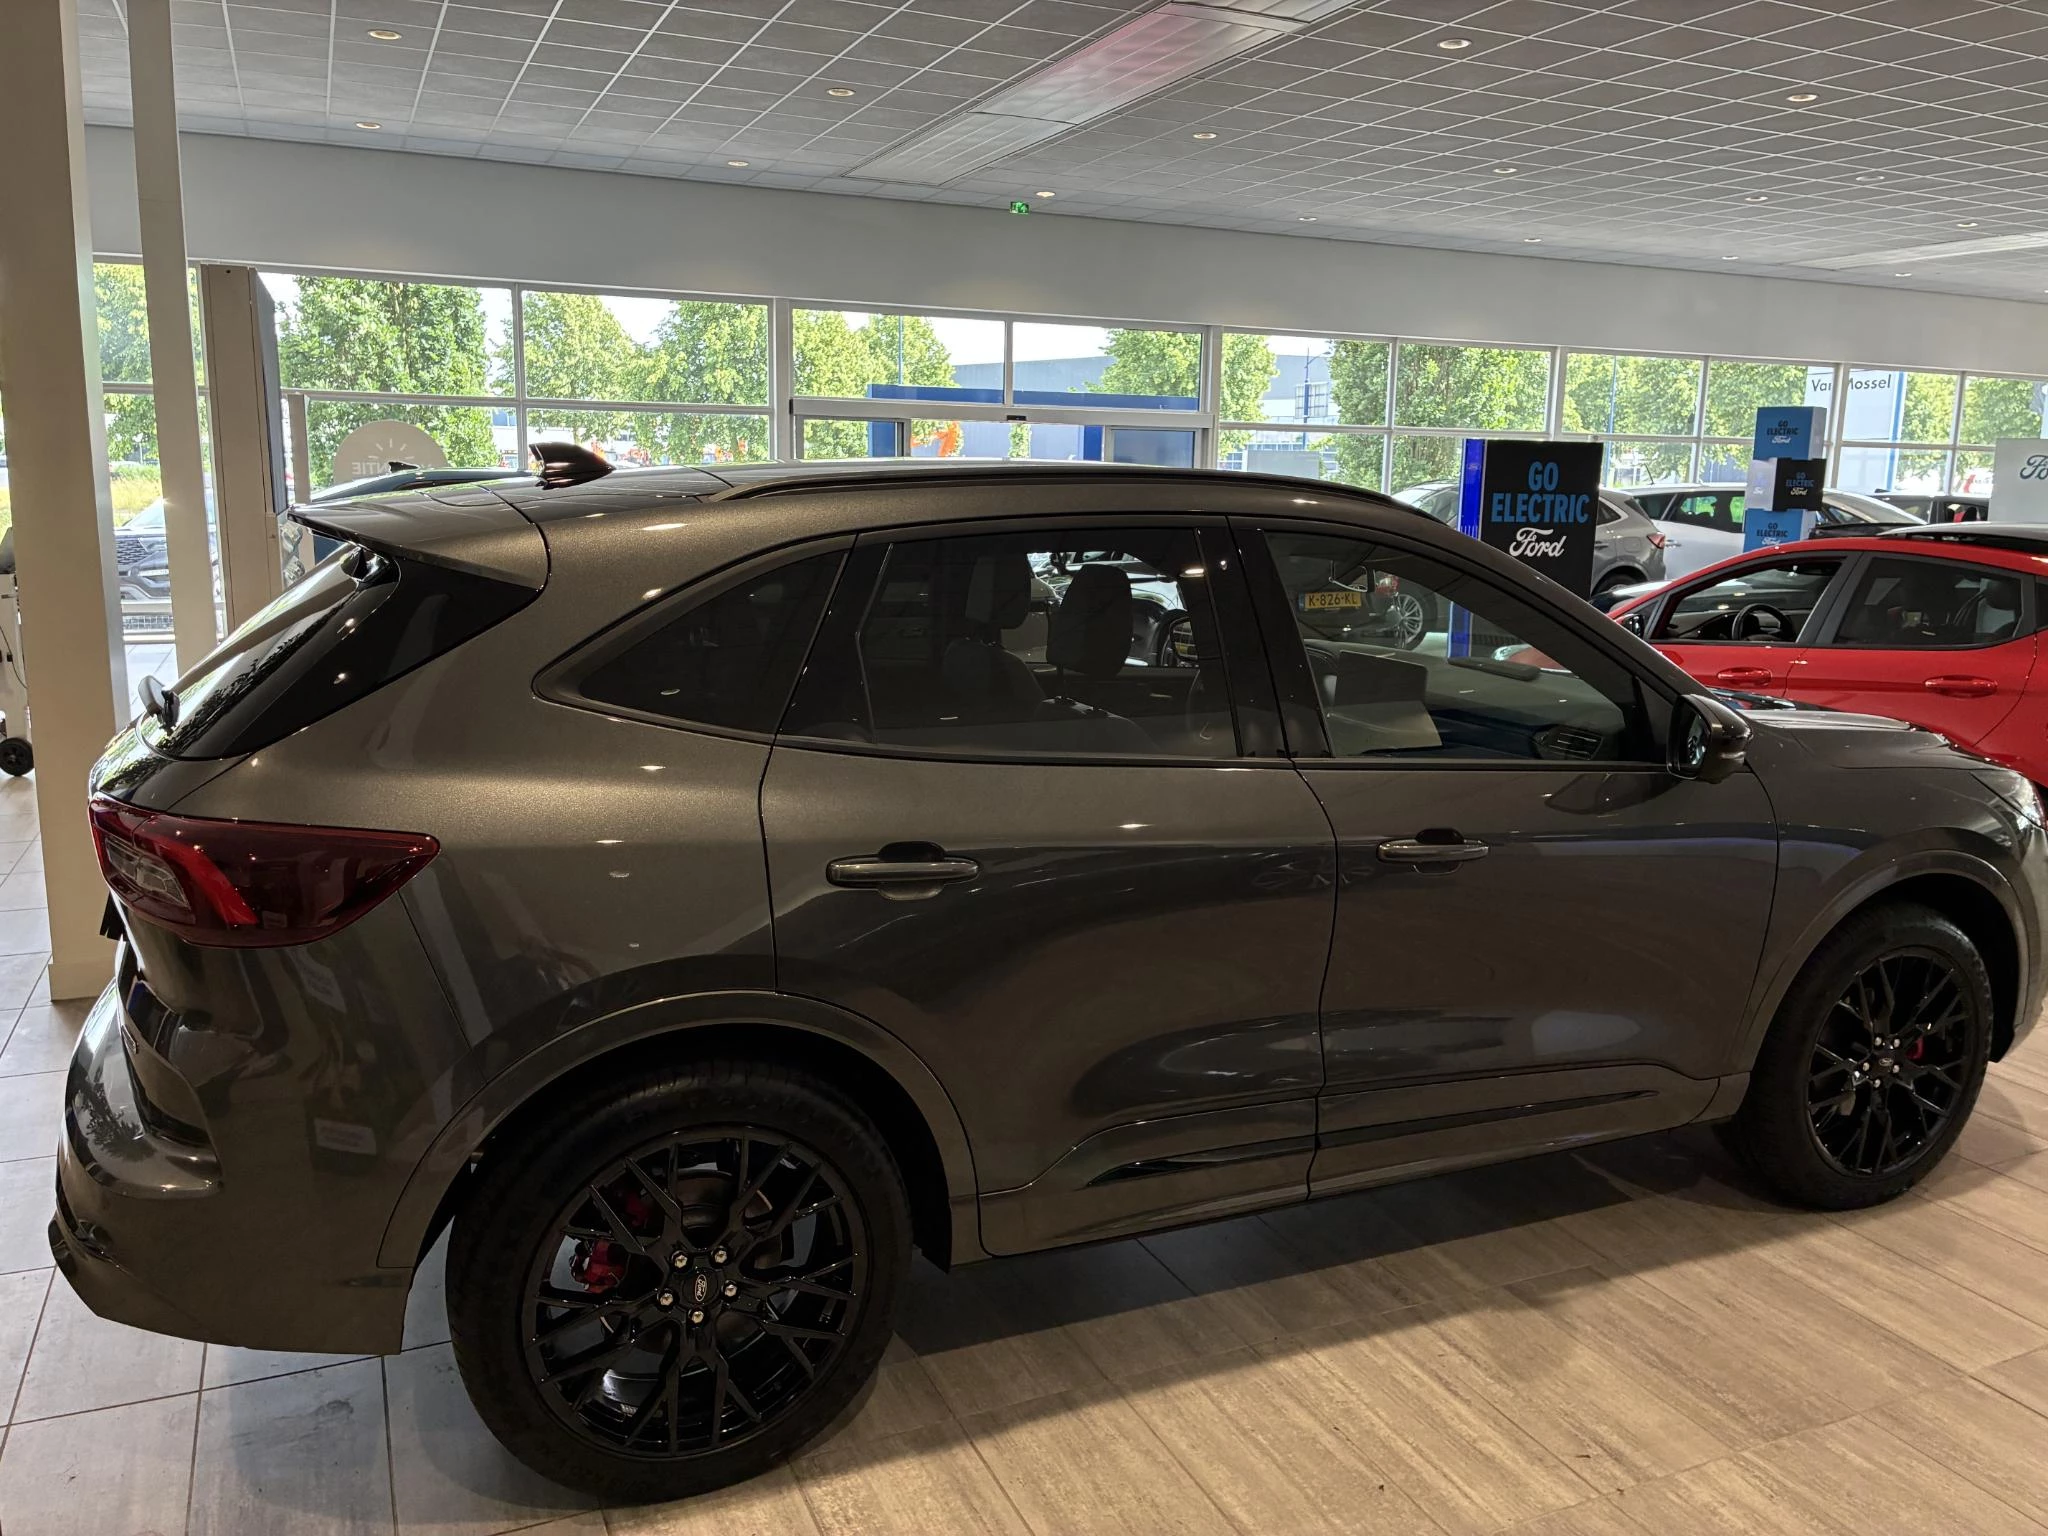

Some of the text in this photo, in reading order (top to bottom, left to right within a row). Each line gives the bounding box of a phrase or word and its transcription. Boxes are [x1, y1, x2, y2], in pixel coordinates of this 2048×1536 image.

[1528, 461, 1559, 492] GO
[1491, 493, 1590, 523] ELECTRIC
[1509, 527, 1567, 557] Ford
[1308, 592, 1358, 607] K-826-KL
